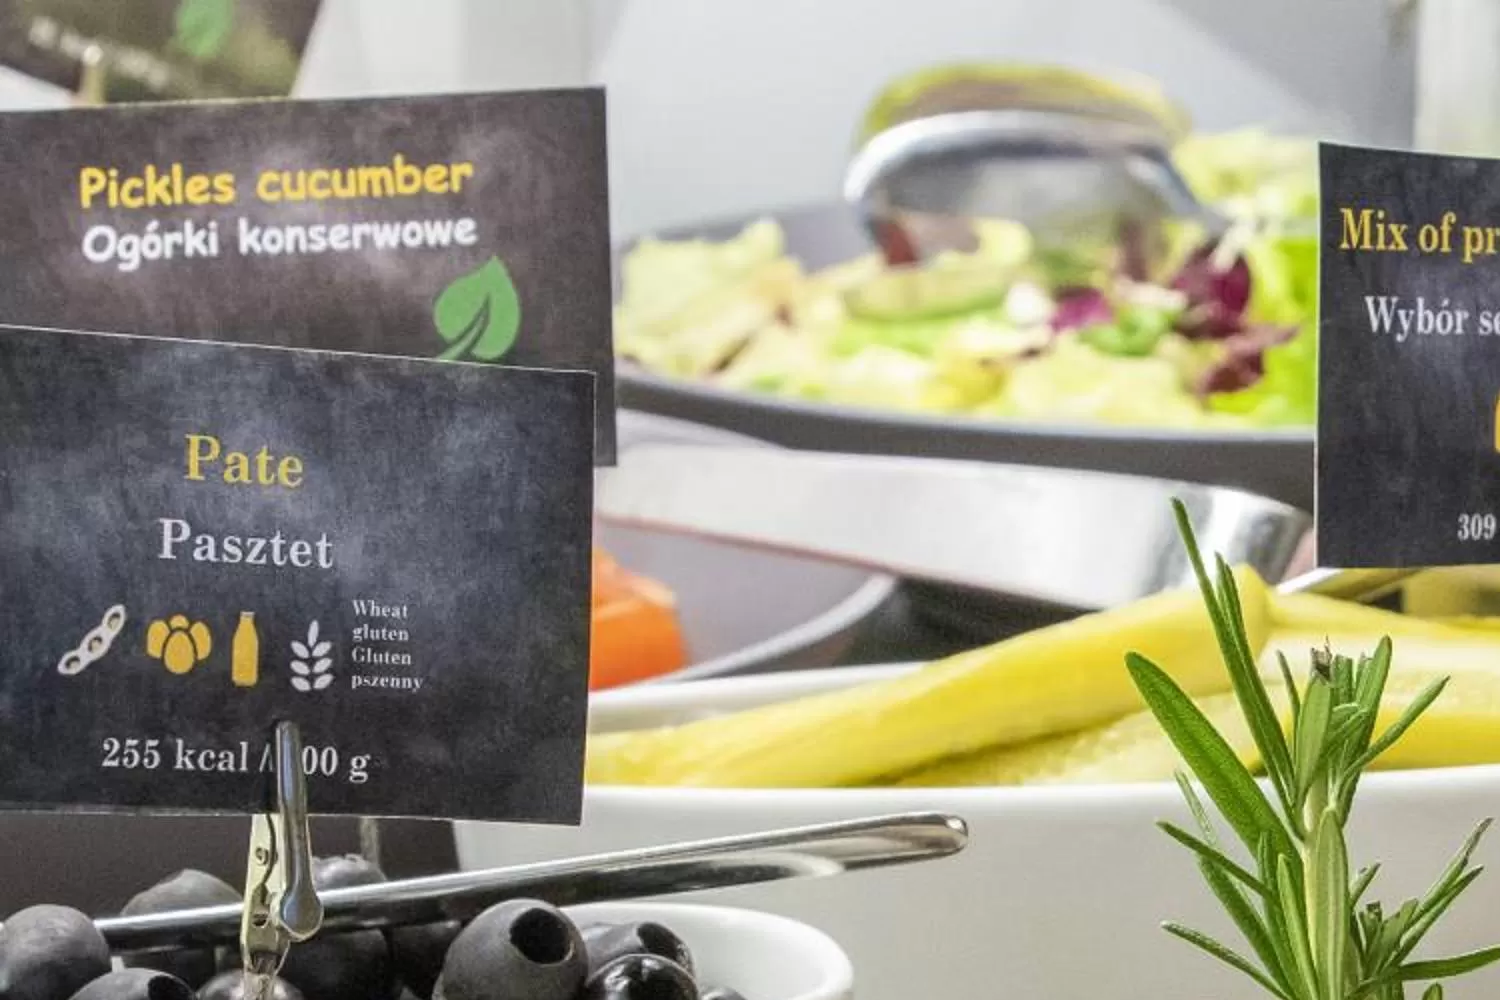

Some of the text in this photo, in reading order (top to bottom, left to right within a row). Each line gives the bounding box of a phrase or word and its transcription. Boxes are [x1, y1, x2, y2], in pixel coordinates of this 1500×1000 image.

[80, 154, 474, 209] Pickles cucumber
[82, 215, 478, 272] Ogórki konserwowe
[1340, 207, 1408, 251] Mix
[1418, 211, 1457, 253] of
[1365, 296, 1469, 342] Wybór
[185, 434, 304, 487] Pate
[158, 518, 334, 569] Pasztet
[1457, 512, 1497, 541] 309
[352, 599, 408, 618] Wheat
[351, 646, 412, 665] Gluten
[352, 623, 410, 642] gluten
[351, 675, 424, 694] pszenny
[102, 738, 162, 769] 255
[174, 739, 249, 772] kcal
[297, 745, 339, 776] 00
[348, 753, 371, 784] g
